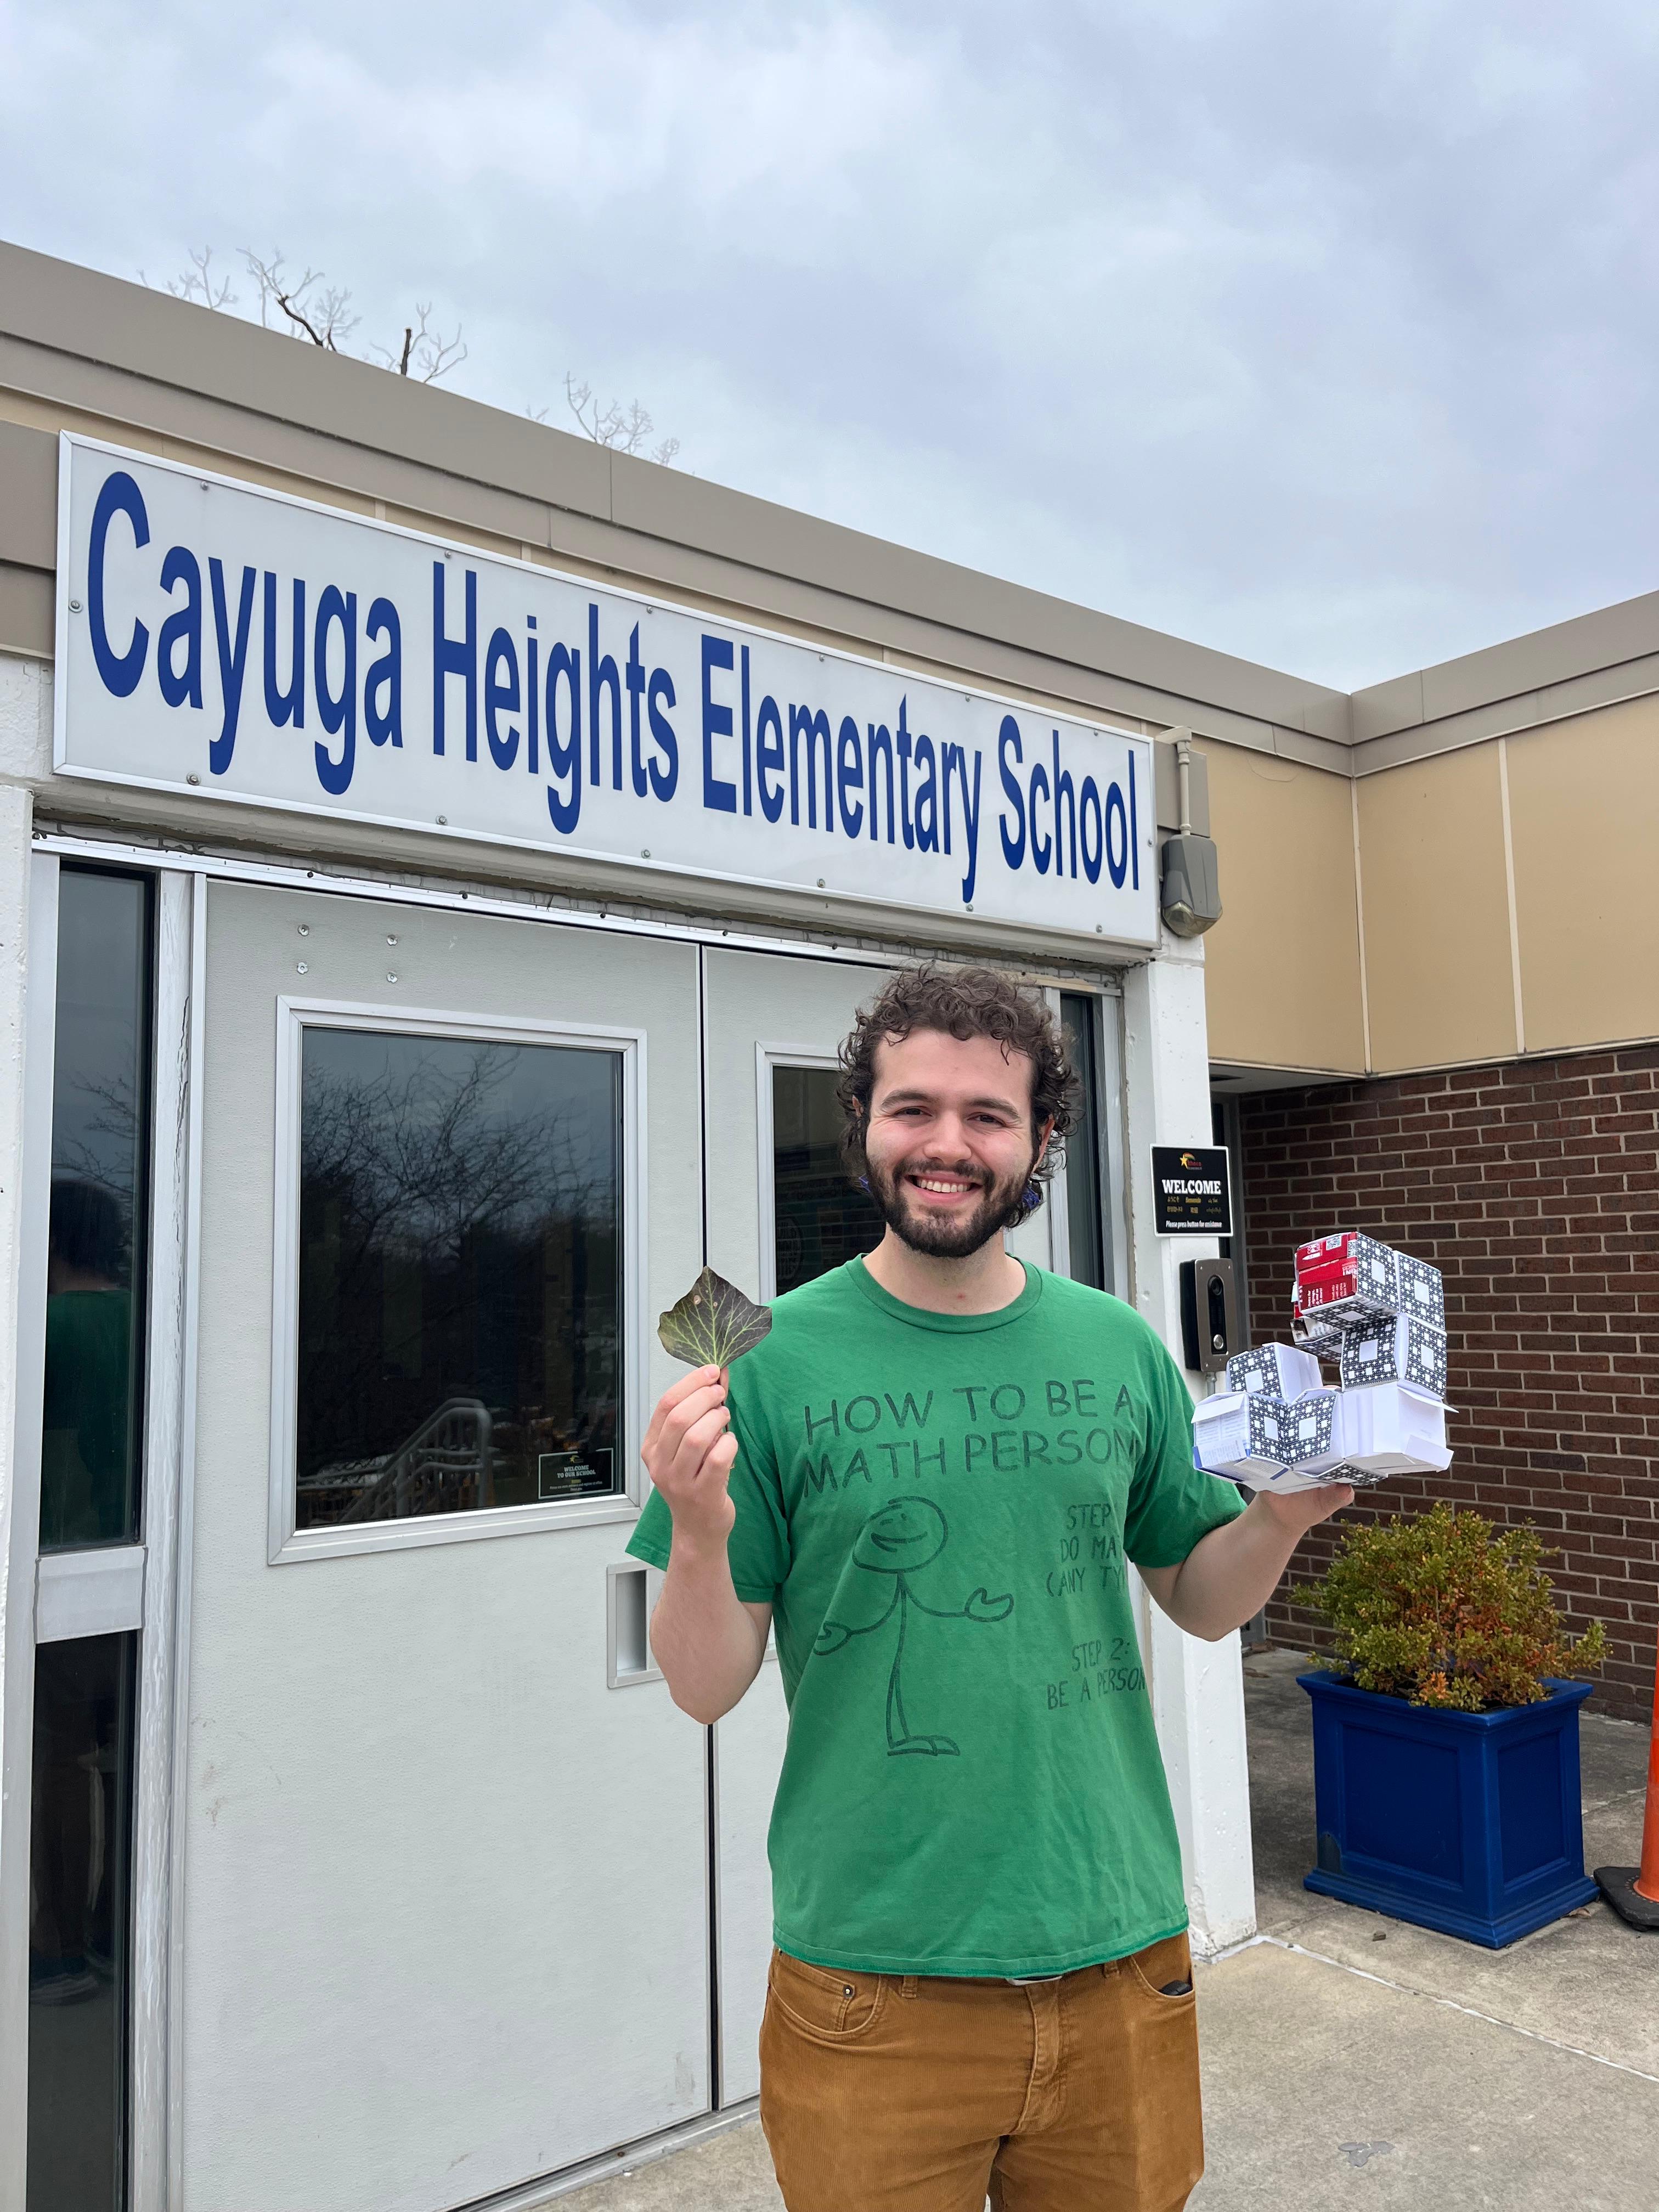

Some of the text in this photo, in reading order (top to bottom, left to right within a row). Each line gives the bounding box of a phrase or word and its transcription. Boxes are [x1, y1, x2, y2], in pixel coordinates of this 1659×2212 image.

[88, 471, 1139, 903] Cayuga Heights Elementary School
[1161, 1180, 1221, 1195] WELCOME
[804, 1379, 1135, 1445] HOW TO BE A
[804, 1437, 947, 1498] MATH
[964, 1428, 1137, 1473] PERSON
[1066, 1503, 1111, 1530] STEP
[1059, 1536, 1079, 1563] DO
[1046, 1566, 1086, 1597] (ANY
[1072, 1638, 1131, 1672] STEP 2:
[1047, 1667, 1146, 1710] BE A PERSON
